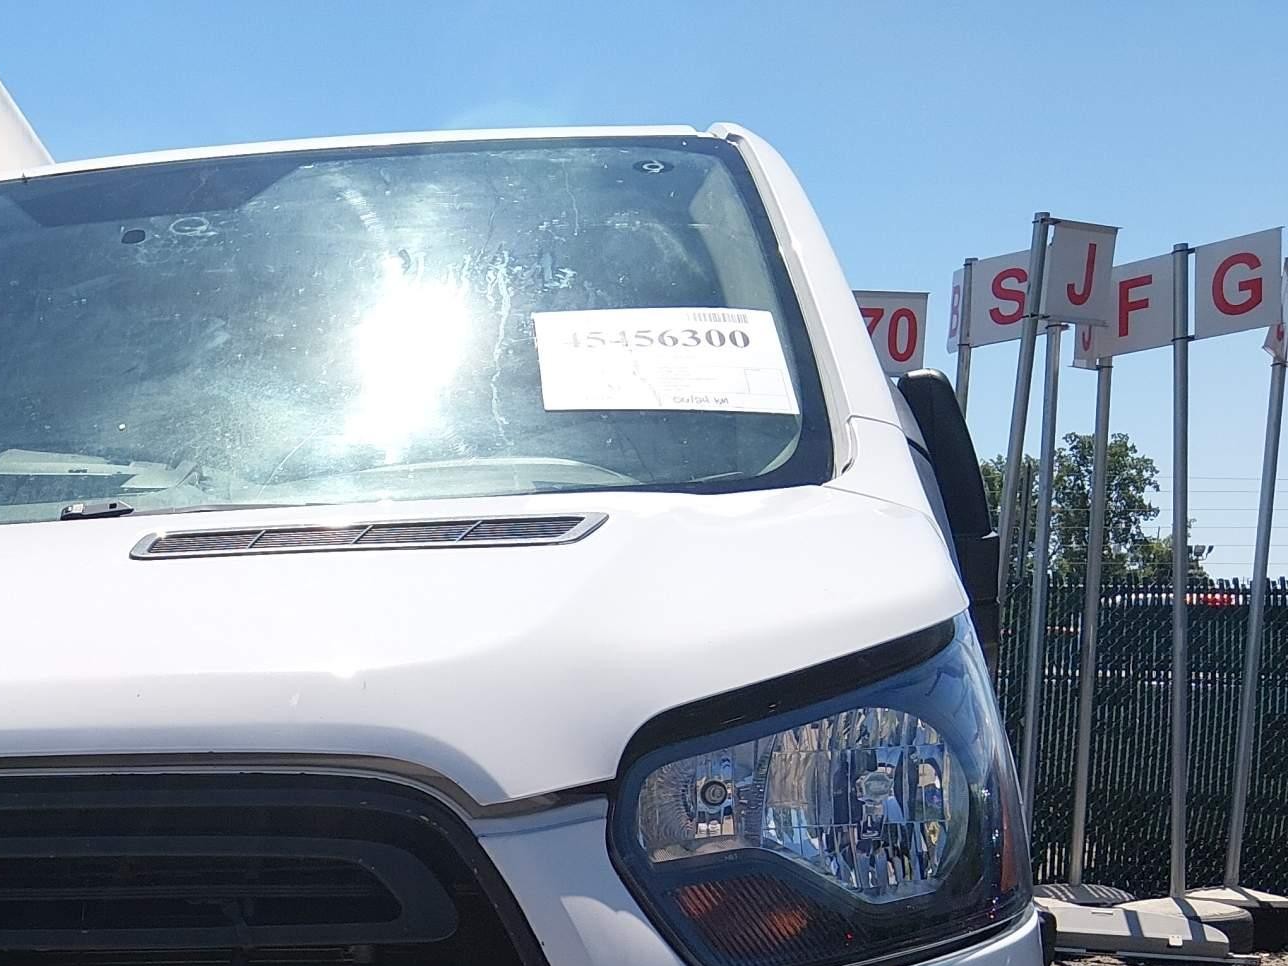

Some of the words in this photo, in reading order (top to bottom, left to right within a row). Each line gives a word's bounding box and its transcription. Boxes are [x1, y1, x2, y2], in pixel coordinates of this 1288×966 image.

[989, 267, 1029, 325] S
[1066, 239, 1097, 306] J
[1212, 252, 1263, 316] G
[564, 327, 751, 349] 45456300
[1118, 274, 1153, 338] F
